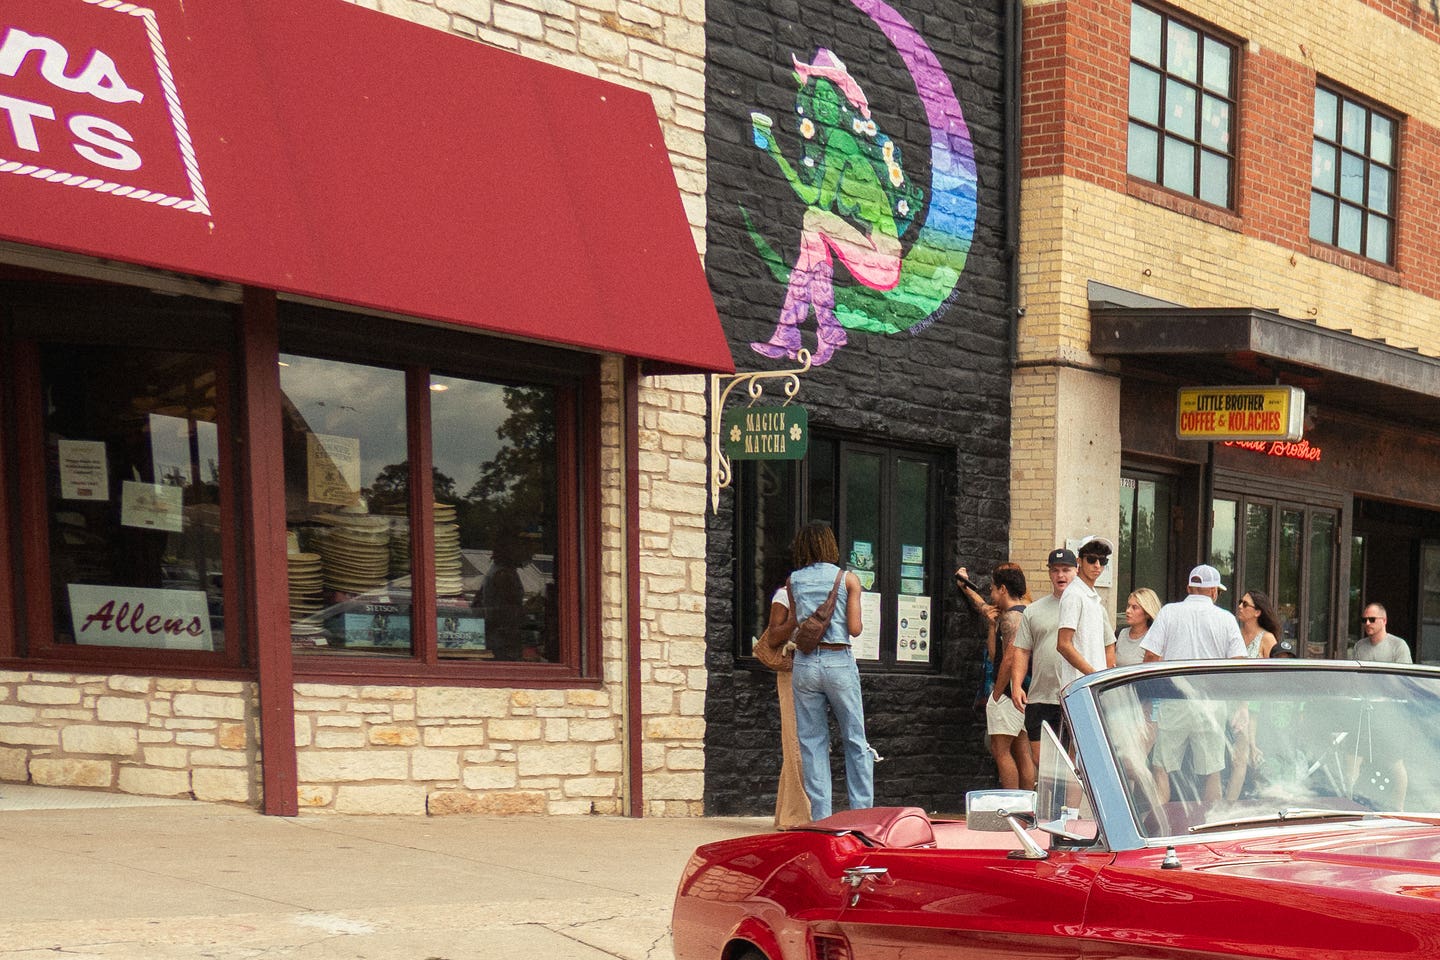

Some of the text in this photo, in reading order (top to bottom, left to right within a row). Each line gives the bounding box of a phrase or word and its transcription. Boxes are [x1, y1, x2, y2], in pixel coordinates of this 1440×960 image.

[1197, 393, 1265, 412] LITTLE BROTHER
[746, 412, 786, 432] MAGICK
[1180, 410, 1281, 432] COFFEE & KOLACHES
[744, 434, 786, 453] MATCHA
[365, 604, 399, 613] STETSON
[80, 600, 205, 637] Allens
